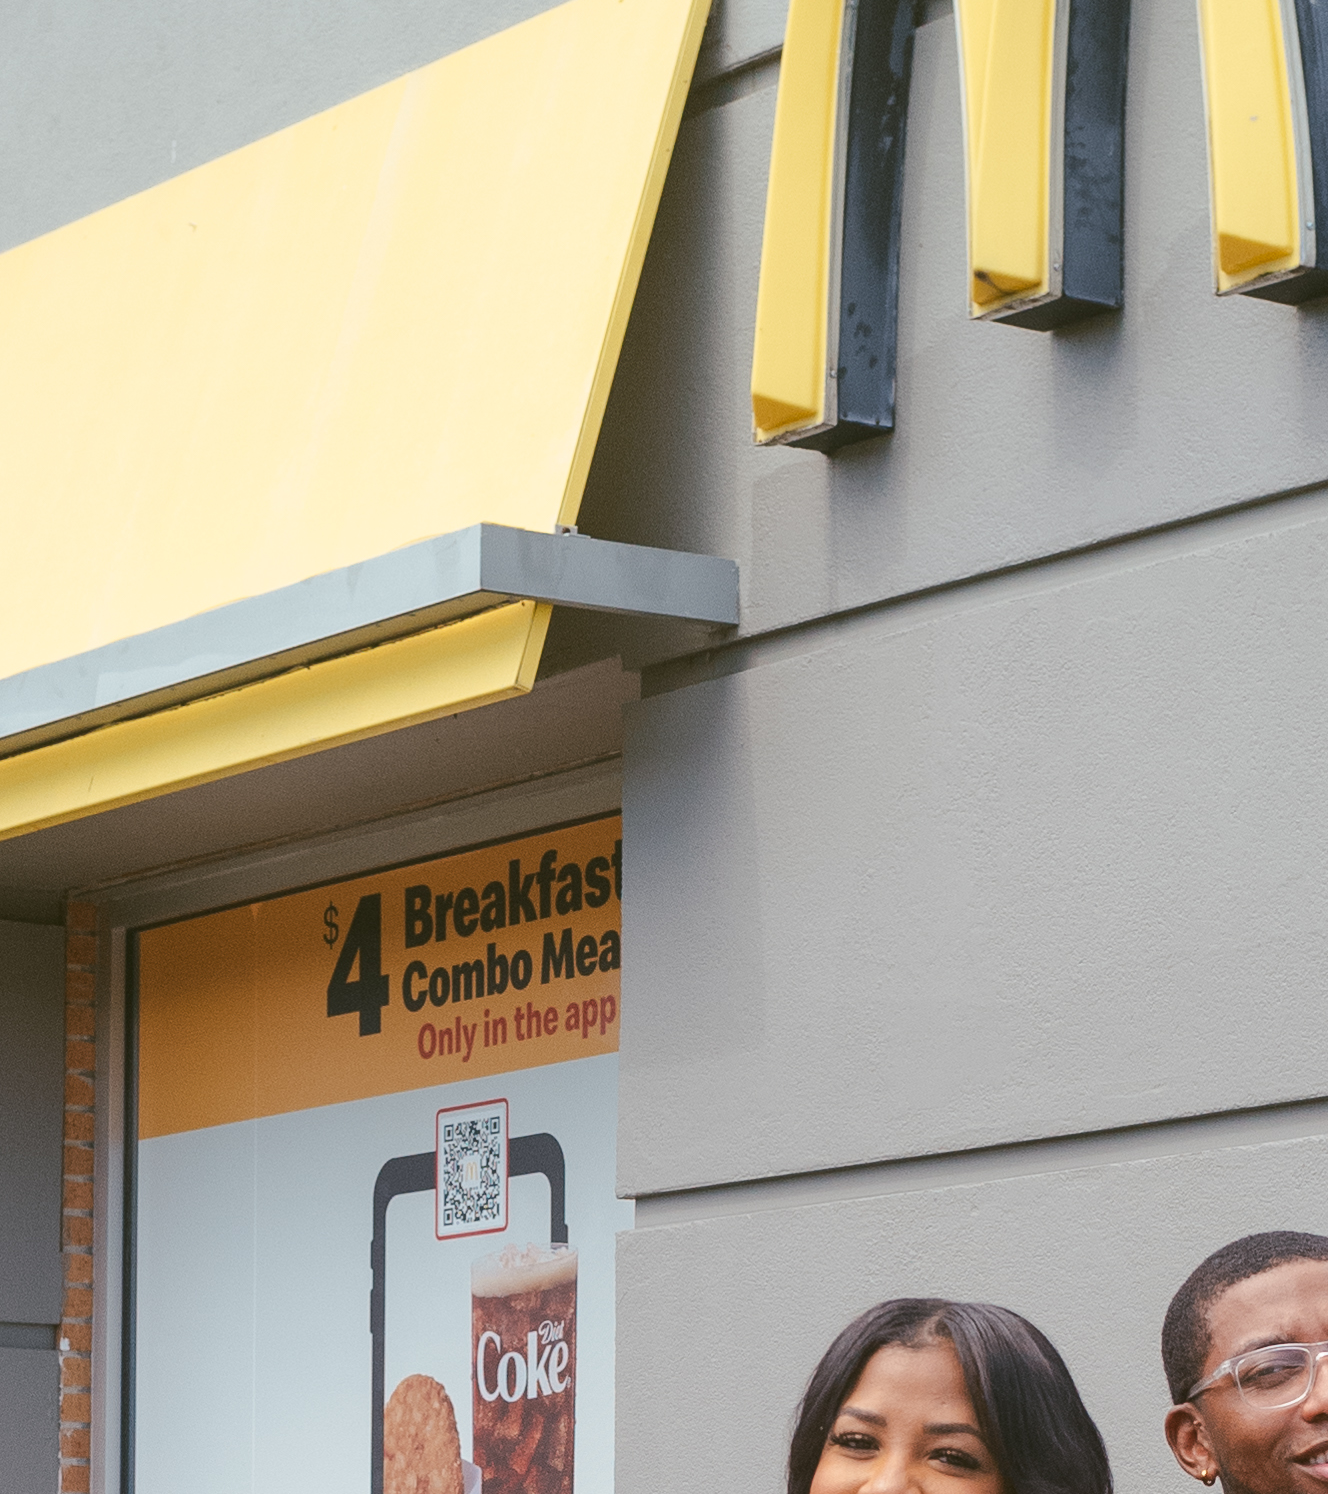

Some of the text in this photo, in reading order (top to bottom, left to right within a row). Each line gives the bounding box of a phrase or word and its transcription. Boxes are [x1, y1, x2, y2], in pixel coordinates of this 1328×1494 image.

[322, 892, 389, 1037] $4
[402, 942, 533, 1012] Combo
[418, 995, 616, 1062] Only in the app
[477, 1331, 568, 1402] Coke
